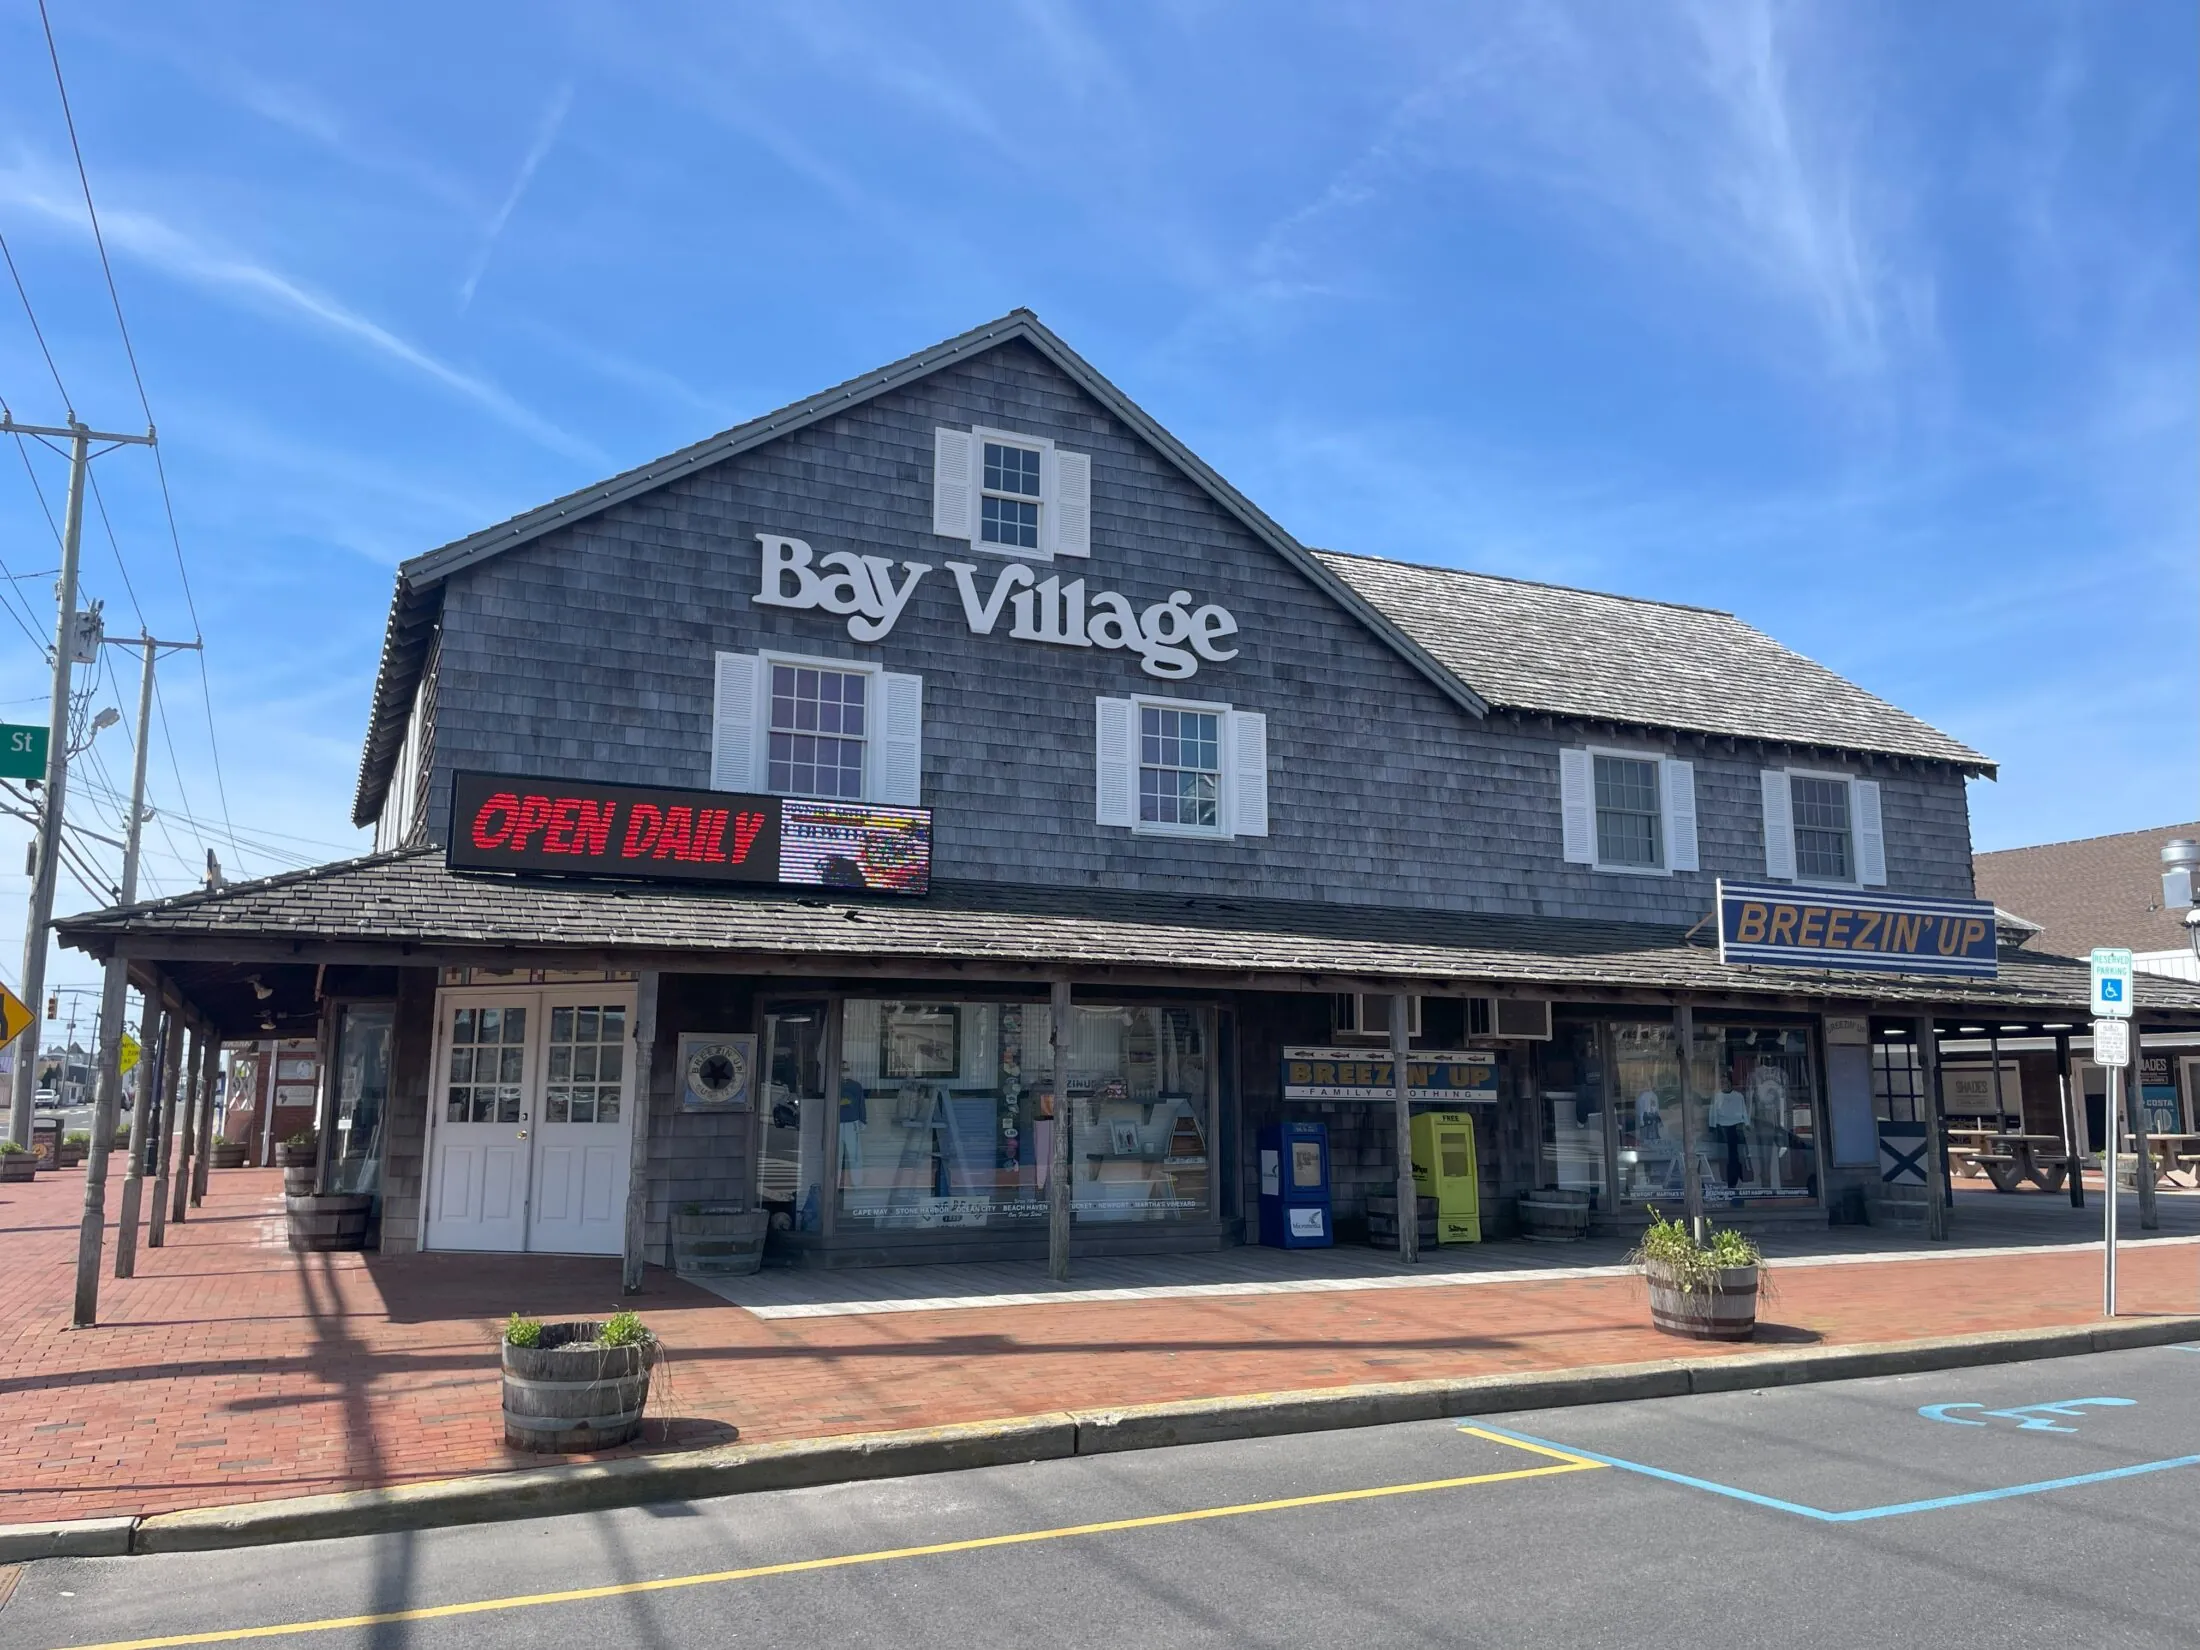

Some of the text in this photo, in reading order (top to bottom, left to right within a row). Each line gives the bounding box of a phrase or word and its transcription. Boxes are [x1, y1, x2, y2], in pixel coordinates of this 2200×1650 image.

[752, 533, 1239, 680] Bay Village
[10, 732, 33, 752] St
[471, 793, 766, 864] OPEN DAILY
[1736, 903, 1986, 957] BREEZIN' UP
[2094, 955, 2130, 964] RESERVED
[2096, 966, 2128, 976] PARKING
[2142, 1058, 2167, 1071] ADES
[1289, 1061, 1491, 1088] BREEZN' UP
[1309, 1087, 1473, 1099] FAMILY COTHING
[1955, 1080, 1988, 1093] SHADES
[852, 1209, 873, 1217] CAPE
[873, 1208, 888, 1216] MAY
[1003, 1204, 1025, 1212] BEACH
[1026, 1203, 1048, 1211] HAVEN
[1098, 1201, 1129, 1209] NEWPORT
